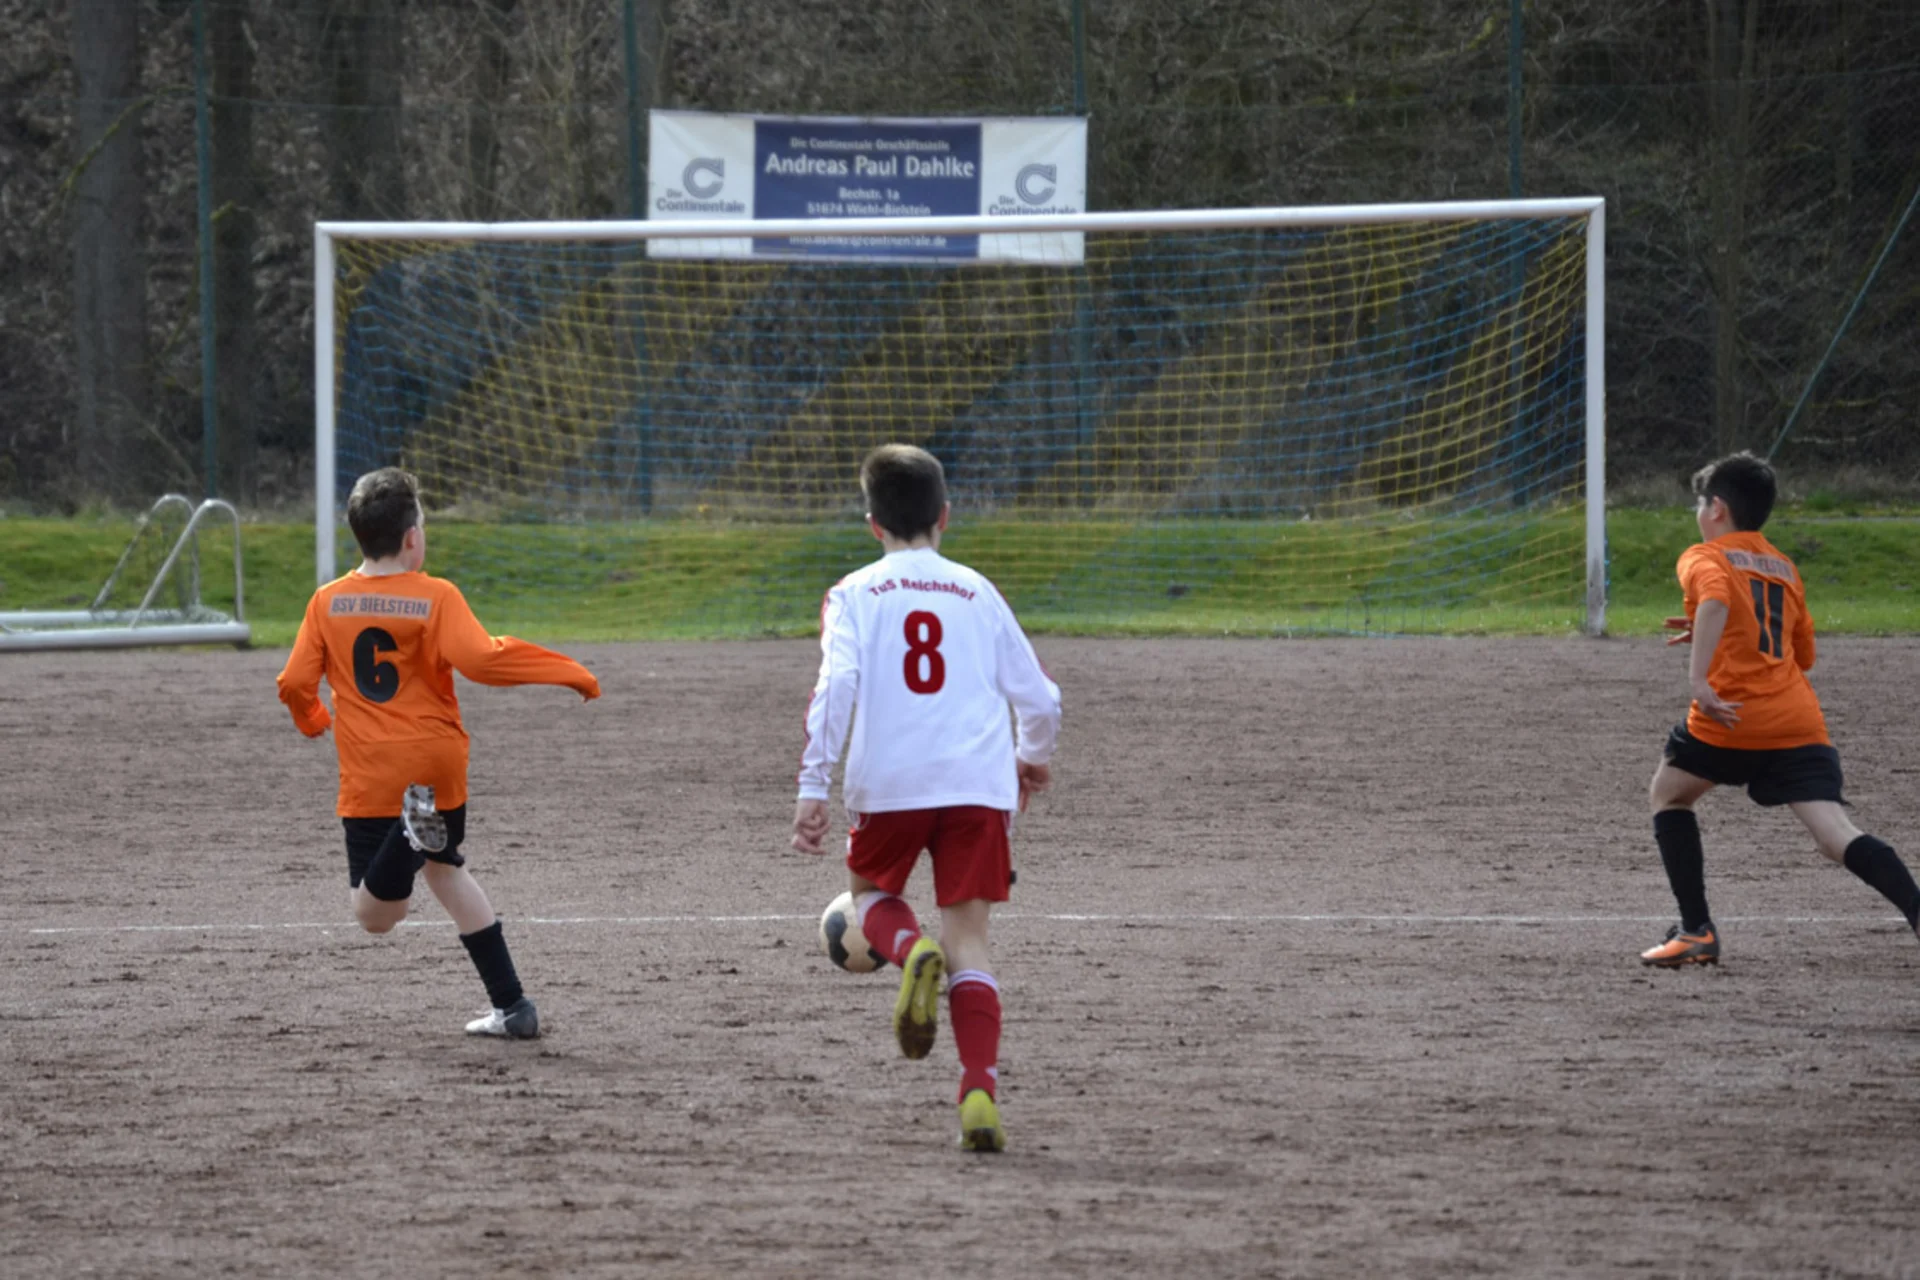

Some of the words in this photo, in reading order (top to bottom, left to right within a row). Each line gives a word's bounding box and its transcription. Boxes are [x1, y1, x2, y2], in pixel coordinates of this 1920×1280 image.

[765, 152, 849, 176] Andreas
[855, 154, 897, 177] Paul
[905, 155, 975, 178] Dahlke
[656, 198, 745, 213] Continentale
[868, 578, 897, 596] TuS
[900, 577, 976, 601] Reichshof
[359, 596, 428, 616] BIELSTEIN
[1749, 578, 1785, 659] 11
[352, 626, 400, 703] 6
[903, 609, 946, 695] 8
